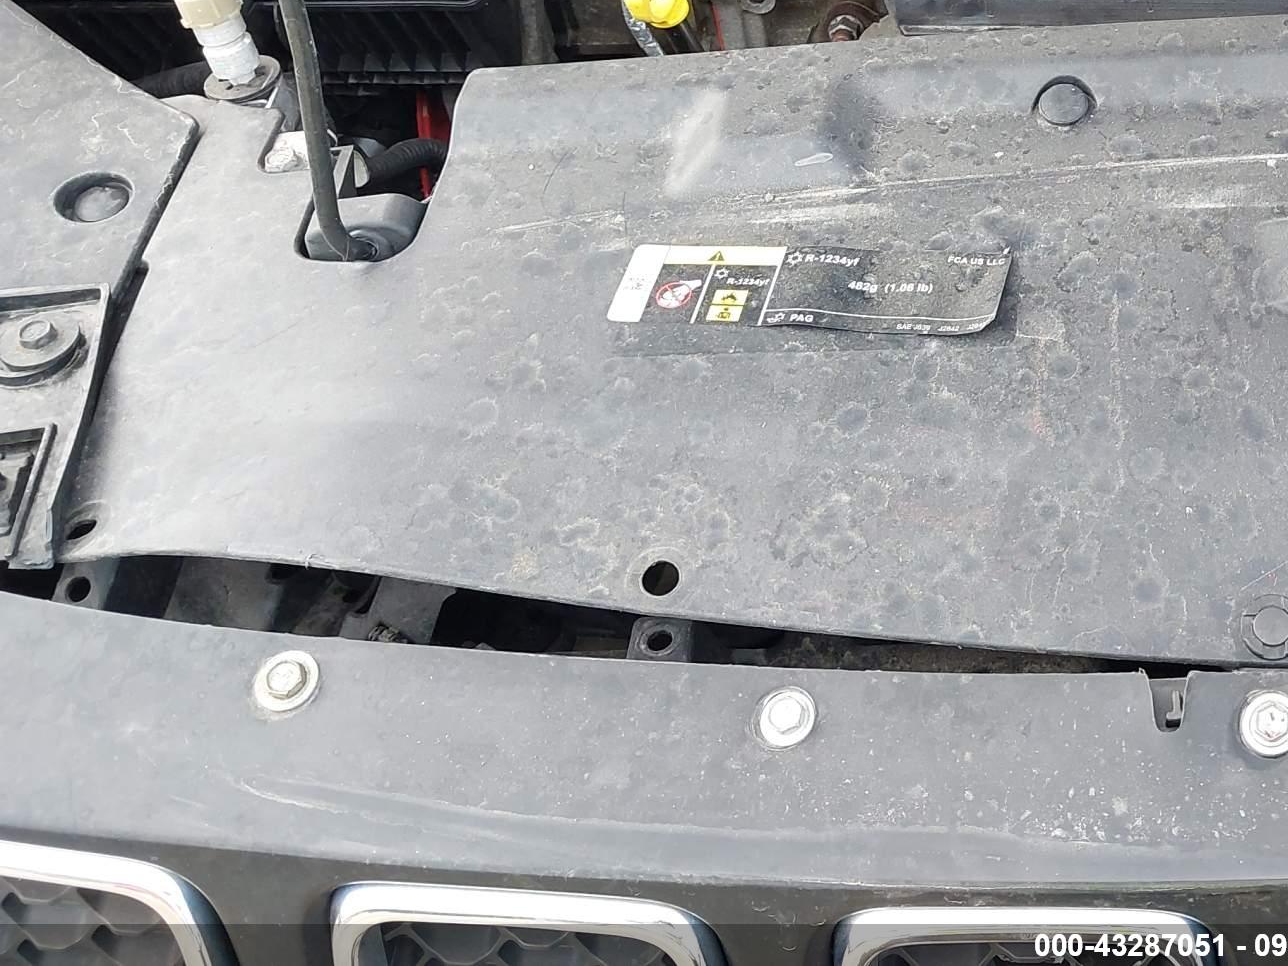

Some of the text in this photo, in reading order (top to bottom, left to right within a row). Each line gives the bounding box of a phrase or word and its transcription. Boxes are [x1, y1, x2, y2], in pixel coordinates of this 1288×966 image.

[804, 253, 861, 268] R-1234yf
[947, 255, 1006, 266] FCA US LLC
[726, 277, 770, 287] R-1234yf
[917, 283, 933, 294] lb)
[789, 313, 814, 323] PAG
